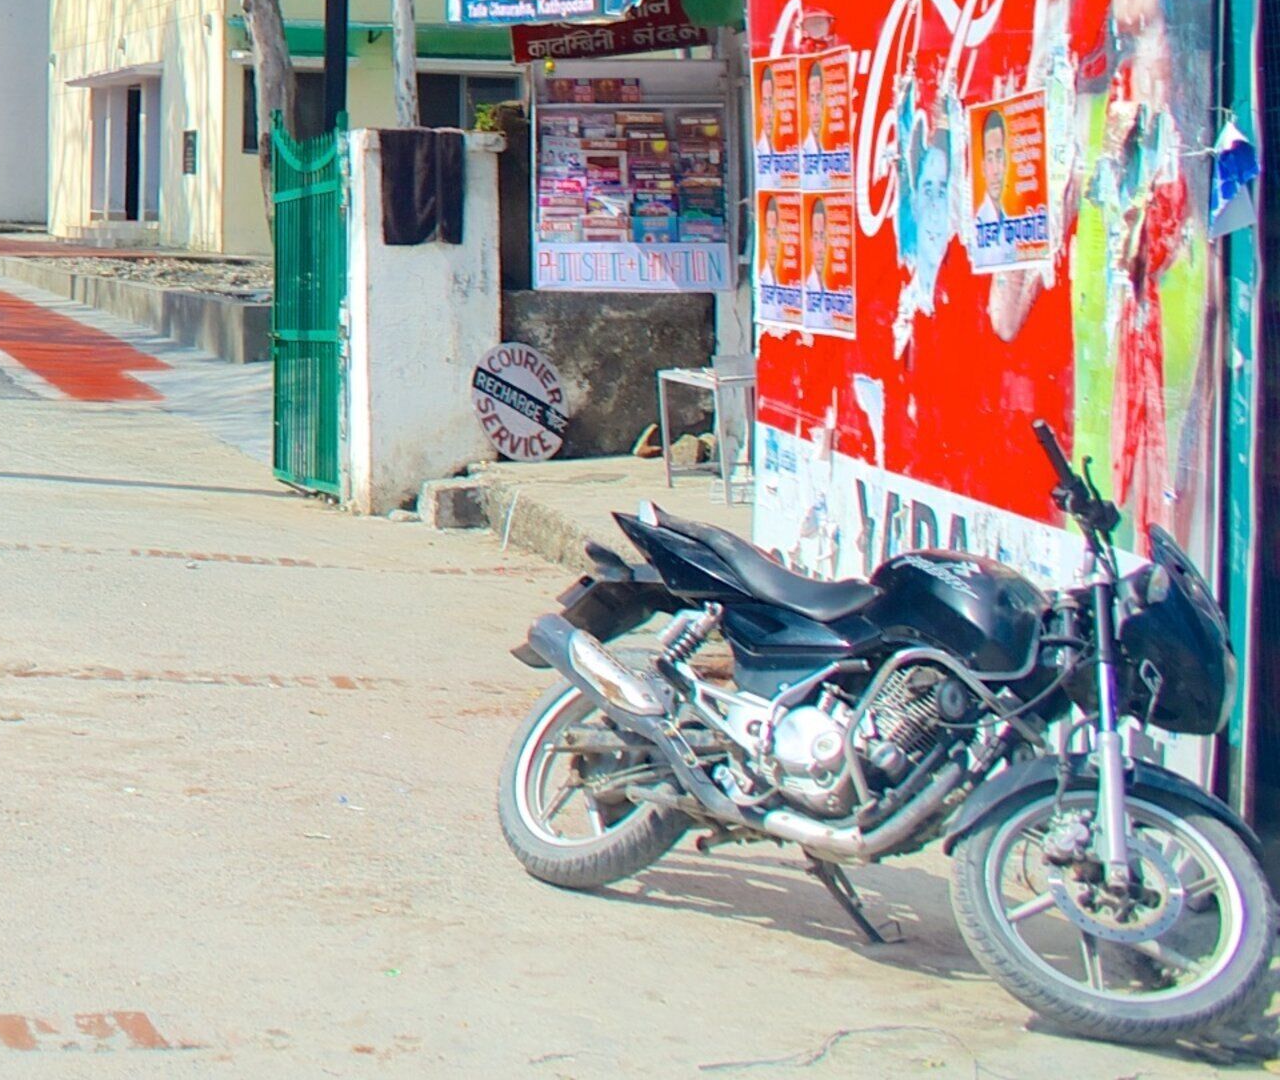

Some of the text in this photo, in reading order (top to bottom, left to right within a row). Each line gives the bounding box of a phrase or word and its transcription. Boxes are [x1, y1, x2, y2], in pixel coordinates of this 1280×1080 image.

[526, 28, 615, 58] कादम्बिनी
[476, 370, 544, 424] RECHARGE
[487, 348, 563, 405] COURIER
[477, 397, 552, 457] SERVICE
